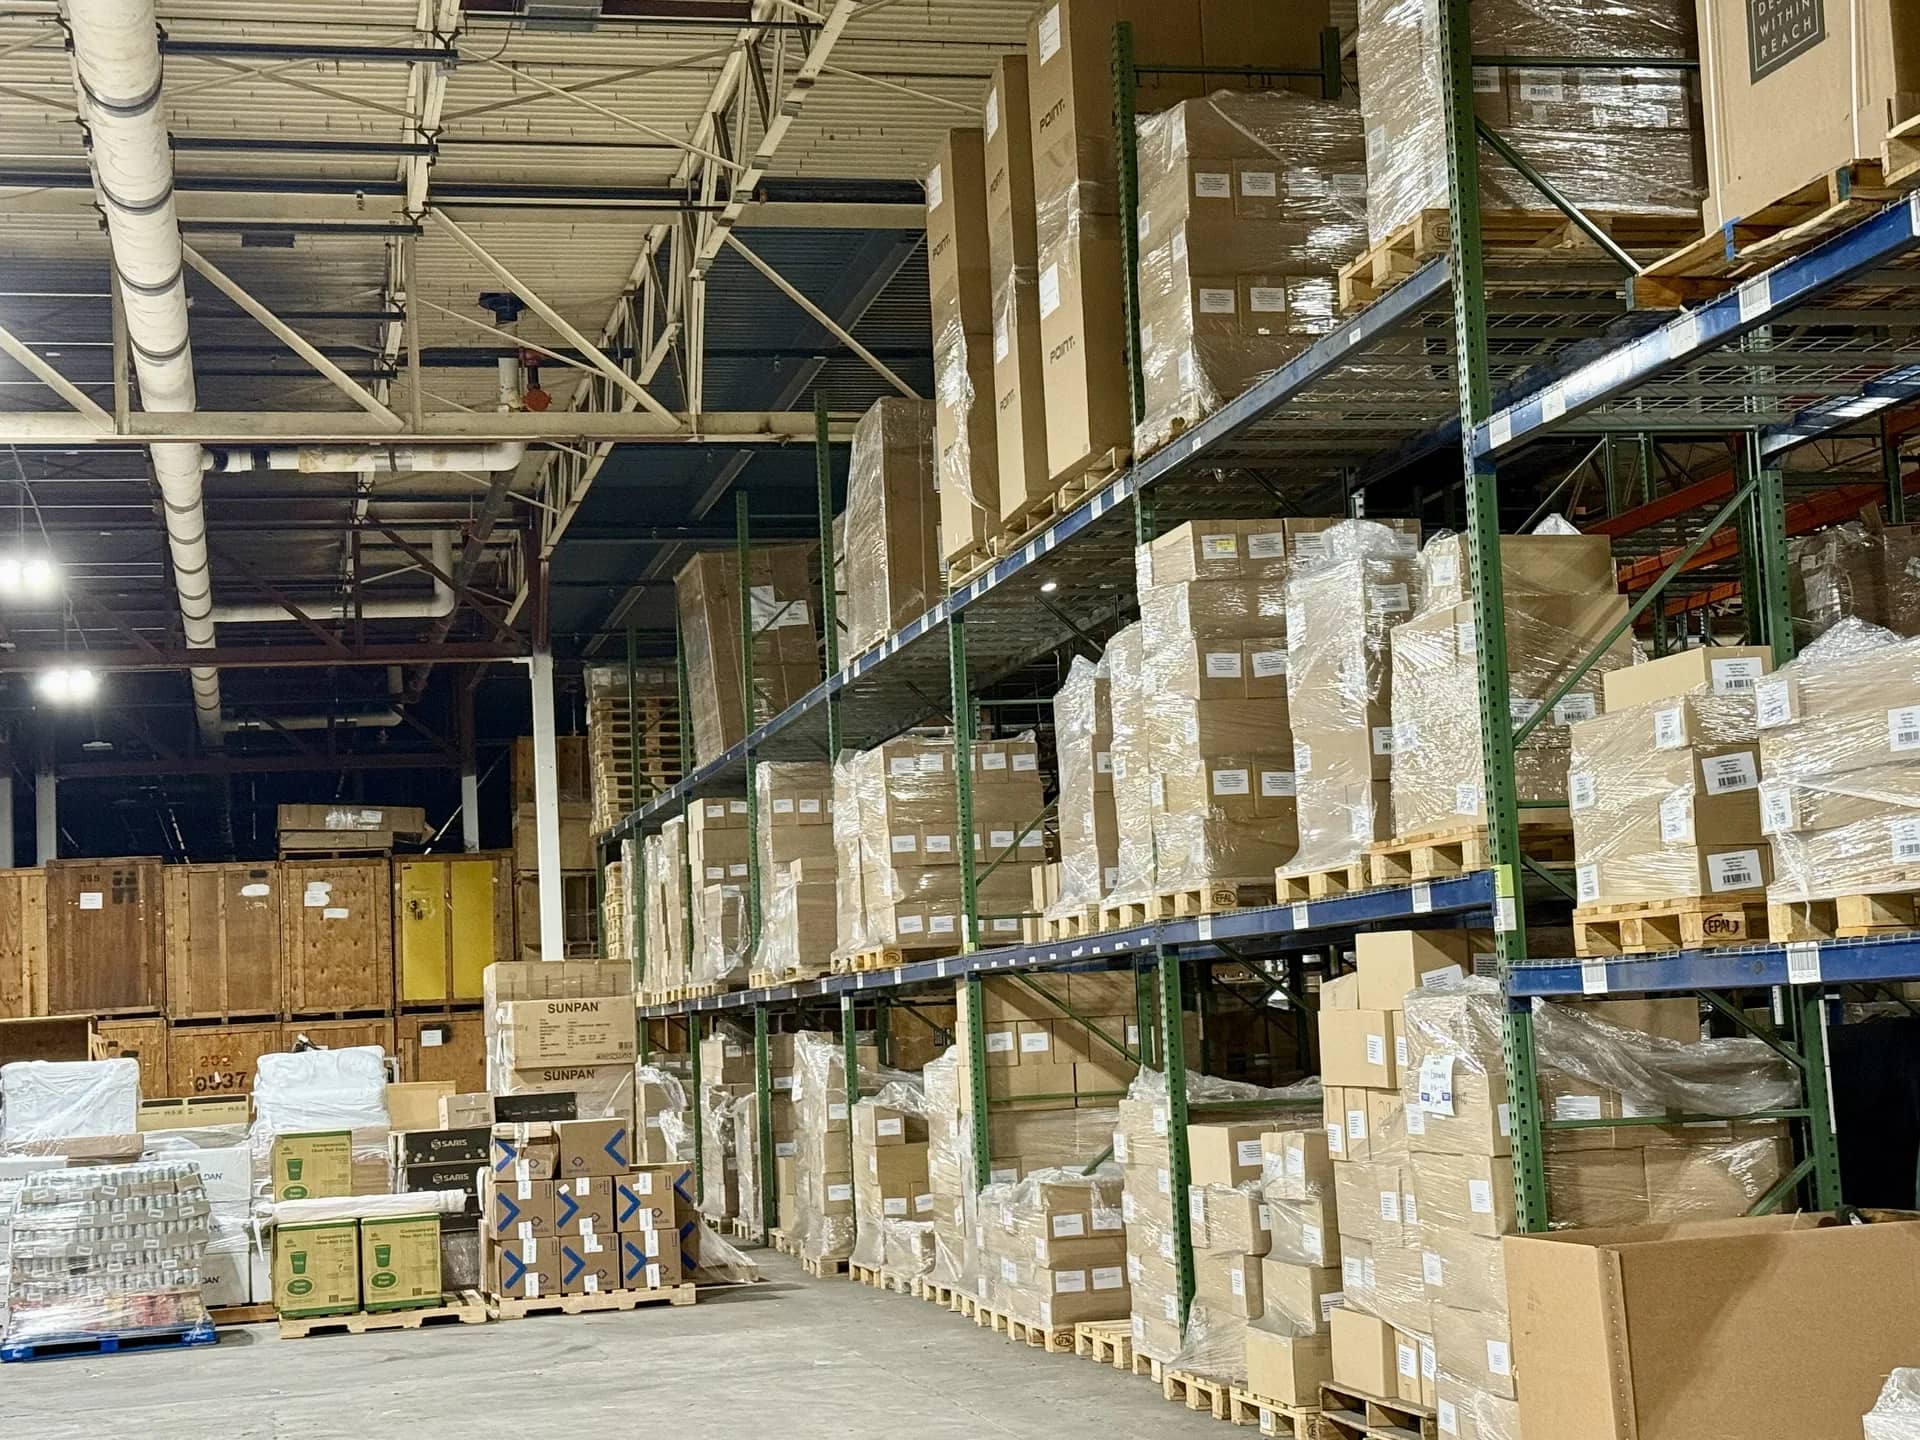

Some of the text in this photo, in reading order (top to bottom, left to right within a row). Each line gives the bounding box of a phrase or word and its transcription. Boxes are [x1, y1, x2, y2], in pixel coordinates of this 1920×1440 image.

[1760, 0, 1810, 37] WITHIN
[1761, 16, 1811, 59] REACH
[547, 1001, 599, 1014] SUNPAN
[543, 1068, 595, 1081] SUNPAN
[441, 1139, 468, 1147] SARIS
[443, 1173, 470, 1182] SARIS
